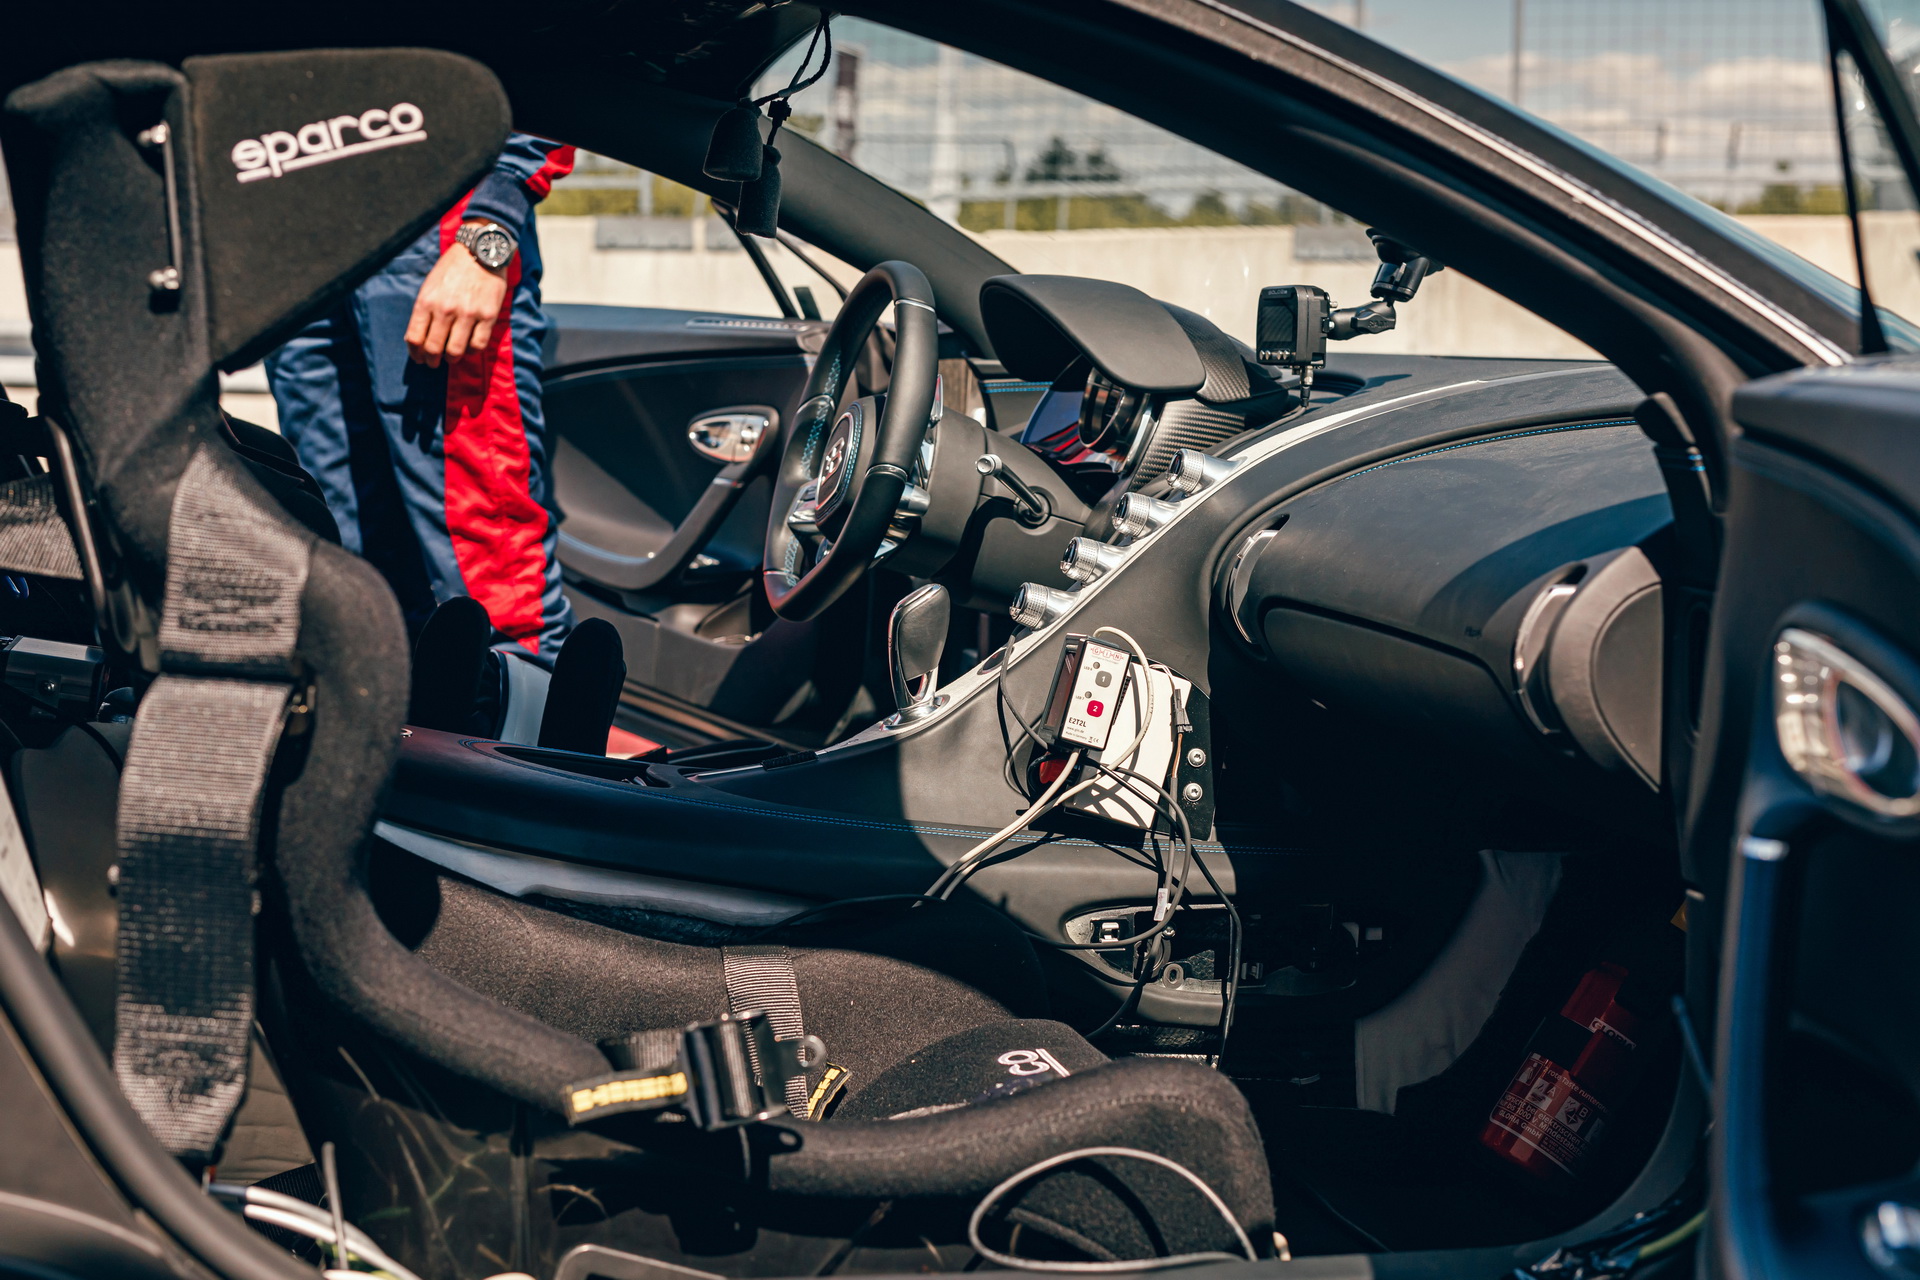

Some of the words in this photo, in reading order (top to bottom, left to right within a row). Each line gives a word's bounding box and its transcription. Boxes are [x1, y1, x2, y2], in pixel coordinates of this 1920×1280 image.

[231, 102, 427, 183] sparco
[1101, 675, 1106, 683] 1
[1068, 717, 1087, 728] E2T2L
[1547, 1069, 1562, 1081] rote
[1561, 1076, 1579, 1092] Taste
[1547, 1086, 1556, 1097] A
[1516, 1107, 1532, 1120] 1000
[1578, 1107, 1589, 1118] B
[1498, 1109, 1520, 1125] GLORIA
[1520, 1122, 1542, 1139] GmbH
[1526, 1104, 1538, 1115] bei
[1537, 1112, 1581, 1146] elektrischen
